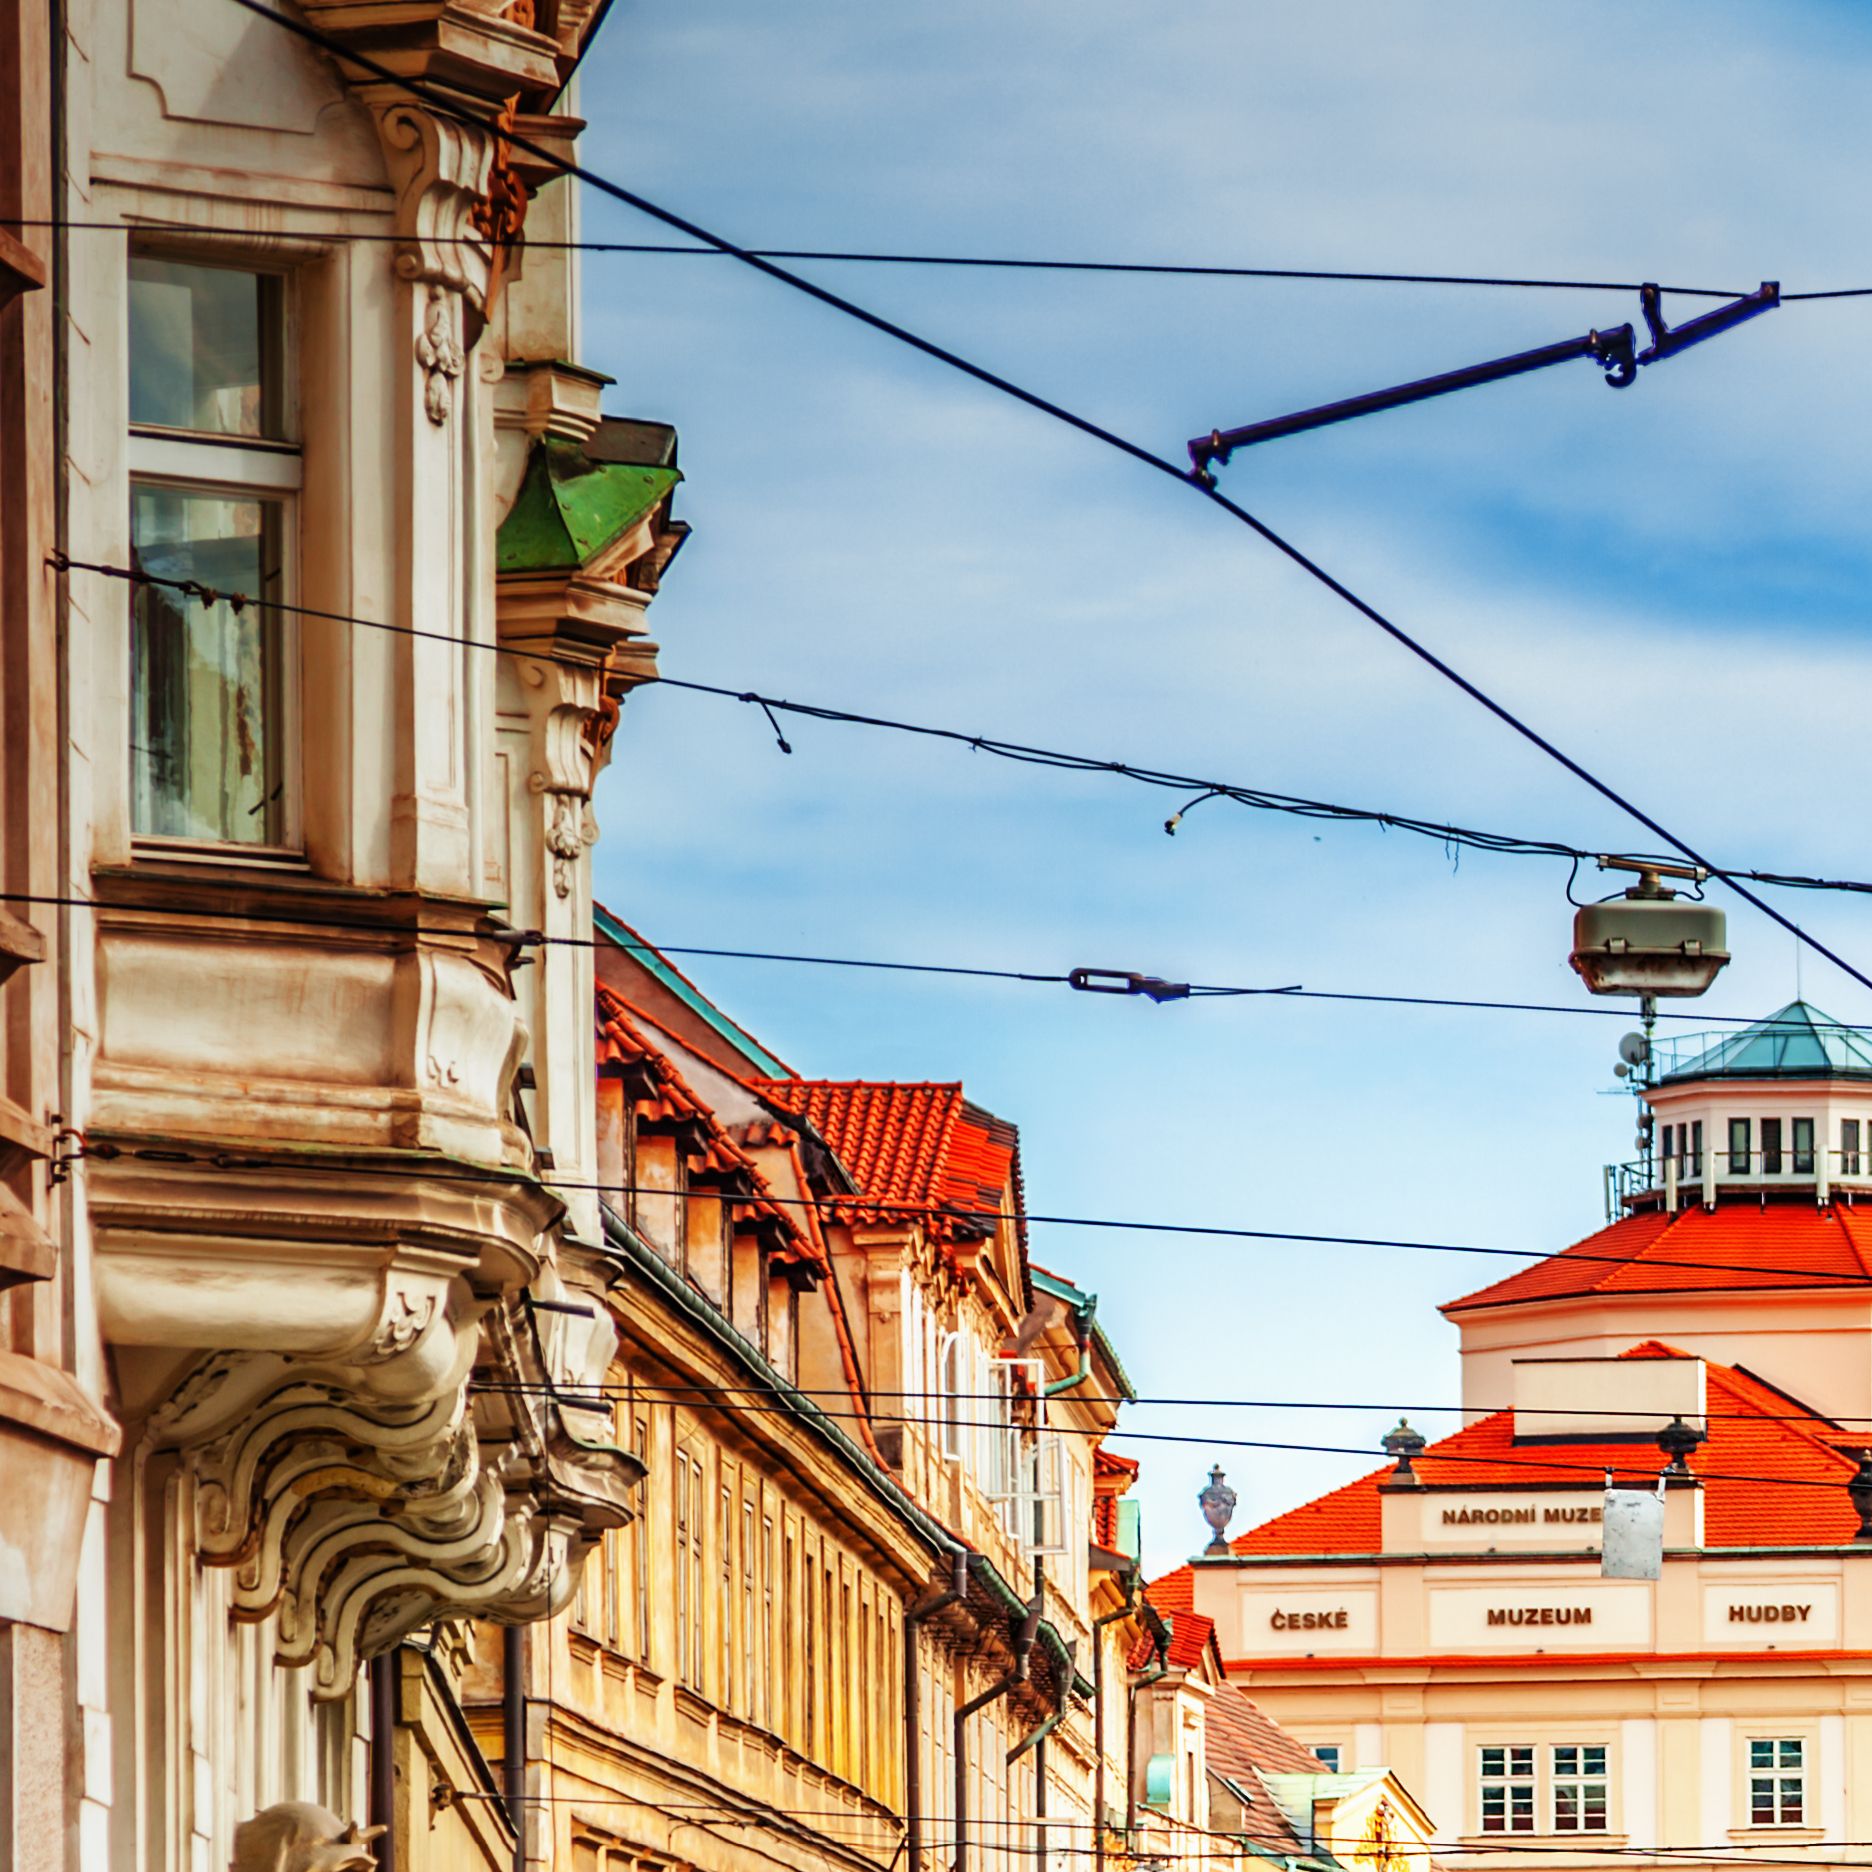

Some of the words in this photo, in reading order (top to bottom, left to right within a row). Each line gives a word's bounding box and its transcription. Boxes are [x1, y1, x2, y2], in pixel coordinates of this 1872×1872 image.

[1442, 1503, 1536, 1525] NÁRODNÍ
[1544, 1507, 1602, 1523] MUZE
[1270, 1607, 1348, 1631] ČESKÉ
[1487, 1607, 1592, 1626] MUZEUM
[1728, 1605, 1811, 1622] HUDBY
